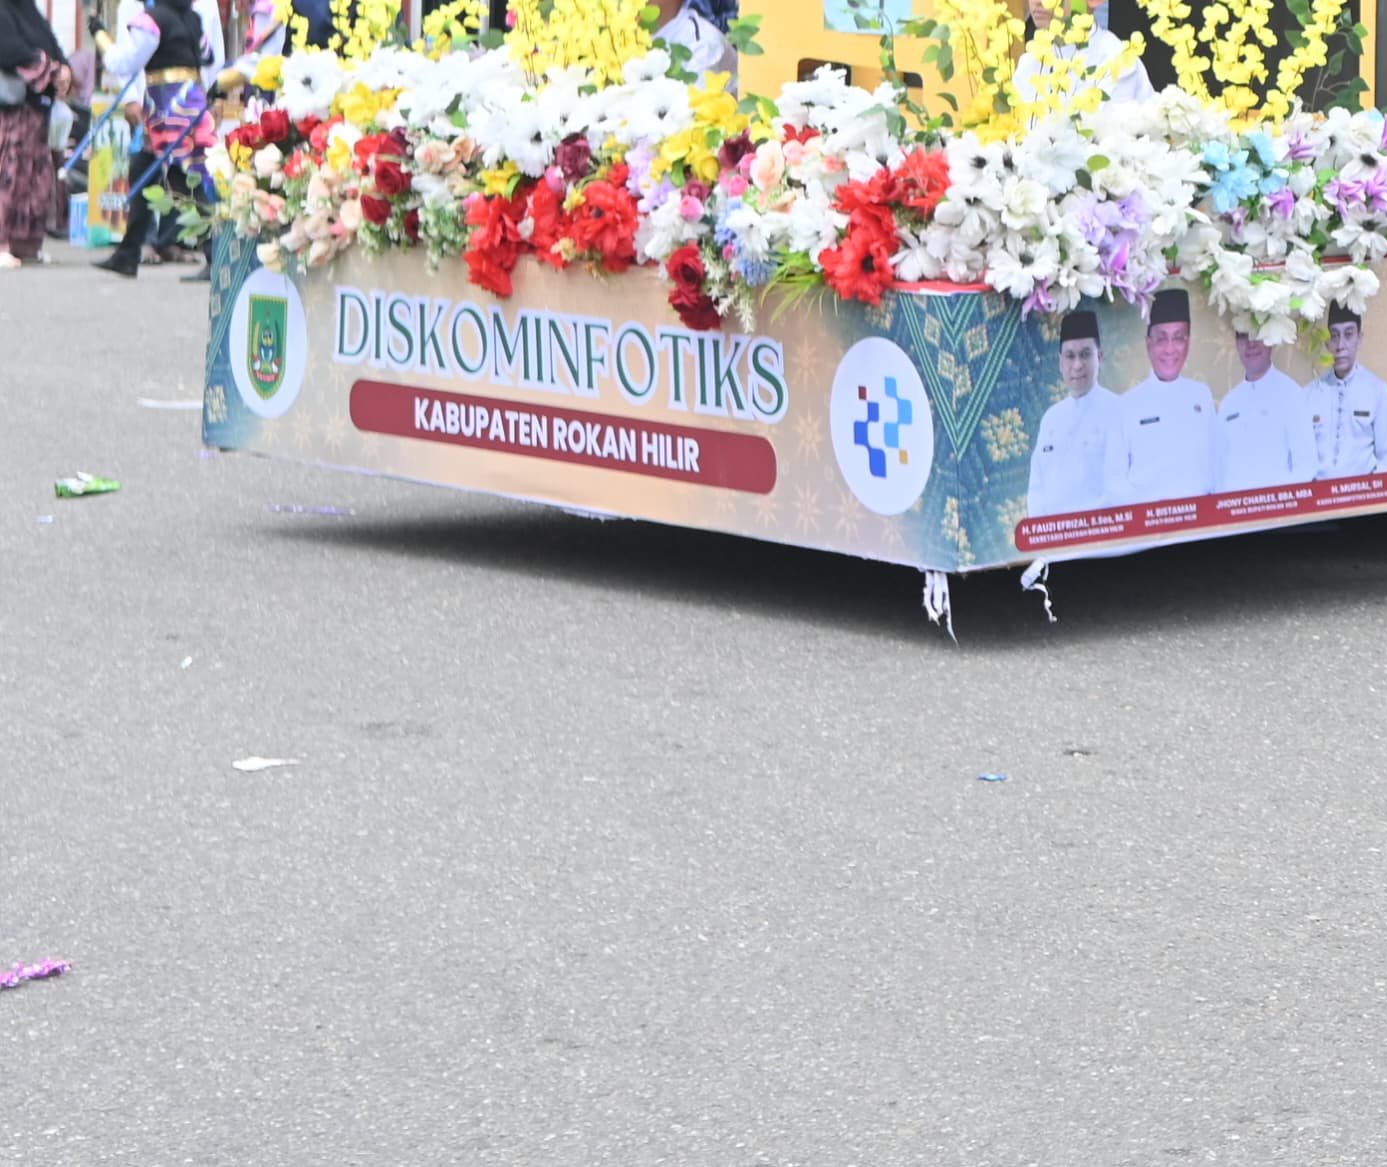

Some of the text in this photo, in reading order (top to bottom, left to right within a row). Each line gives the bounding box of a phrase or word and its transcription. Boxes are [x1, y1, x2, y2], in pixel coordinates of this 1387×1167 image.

[337, 292, 785, 416] DISKOMINFOTIKS
[414, 397, 700, 473] KABUPATEN ROKAN HILIR
